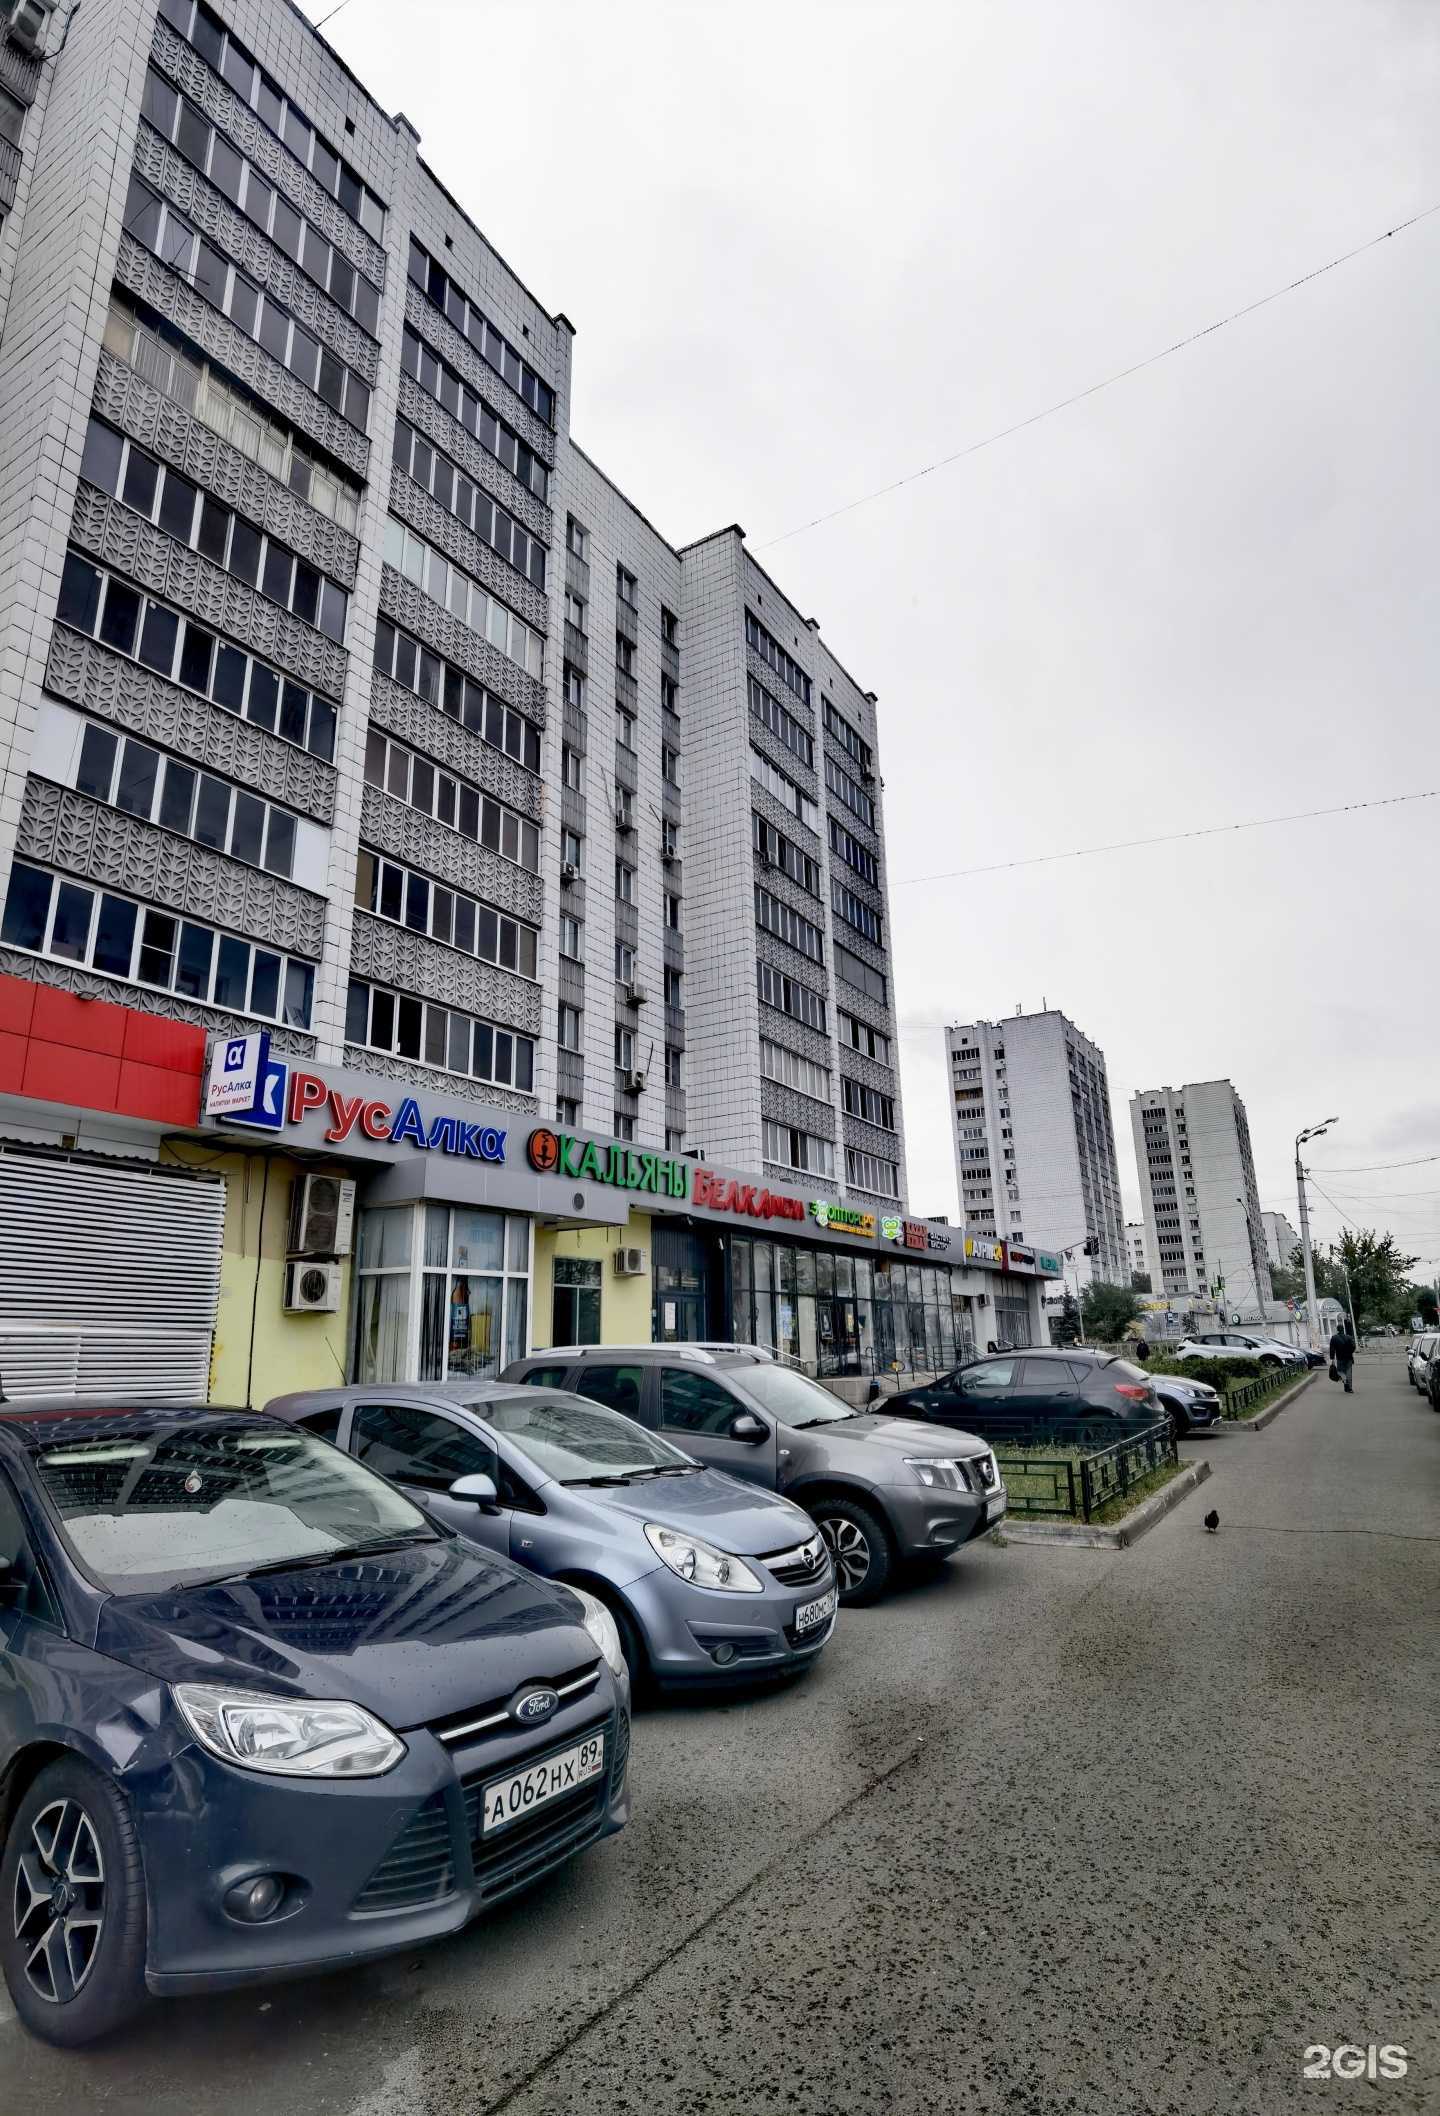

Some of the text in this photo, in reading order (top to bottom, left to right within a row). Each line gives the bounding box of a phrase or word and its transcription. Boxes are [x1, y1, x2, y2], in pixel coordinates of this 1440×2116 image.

[557, 1134, 689, 1198] КАЛЬЯНЫ
[528, 1697, 551, 1718] Ford
[579, 1740, 598, 1768] 89
